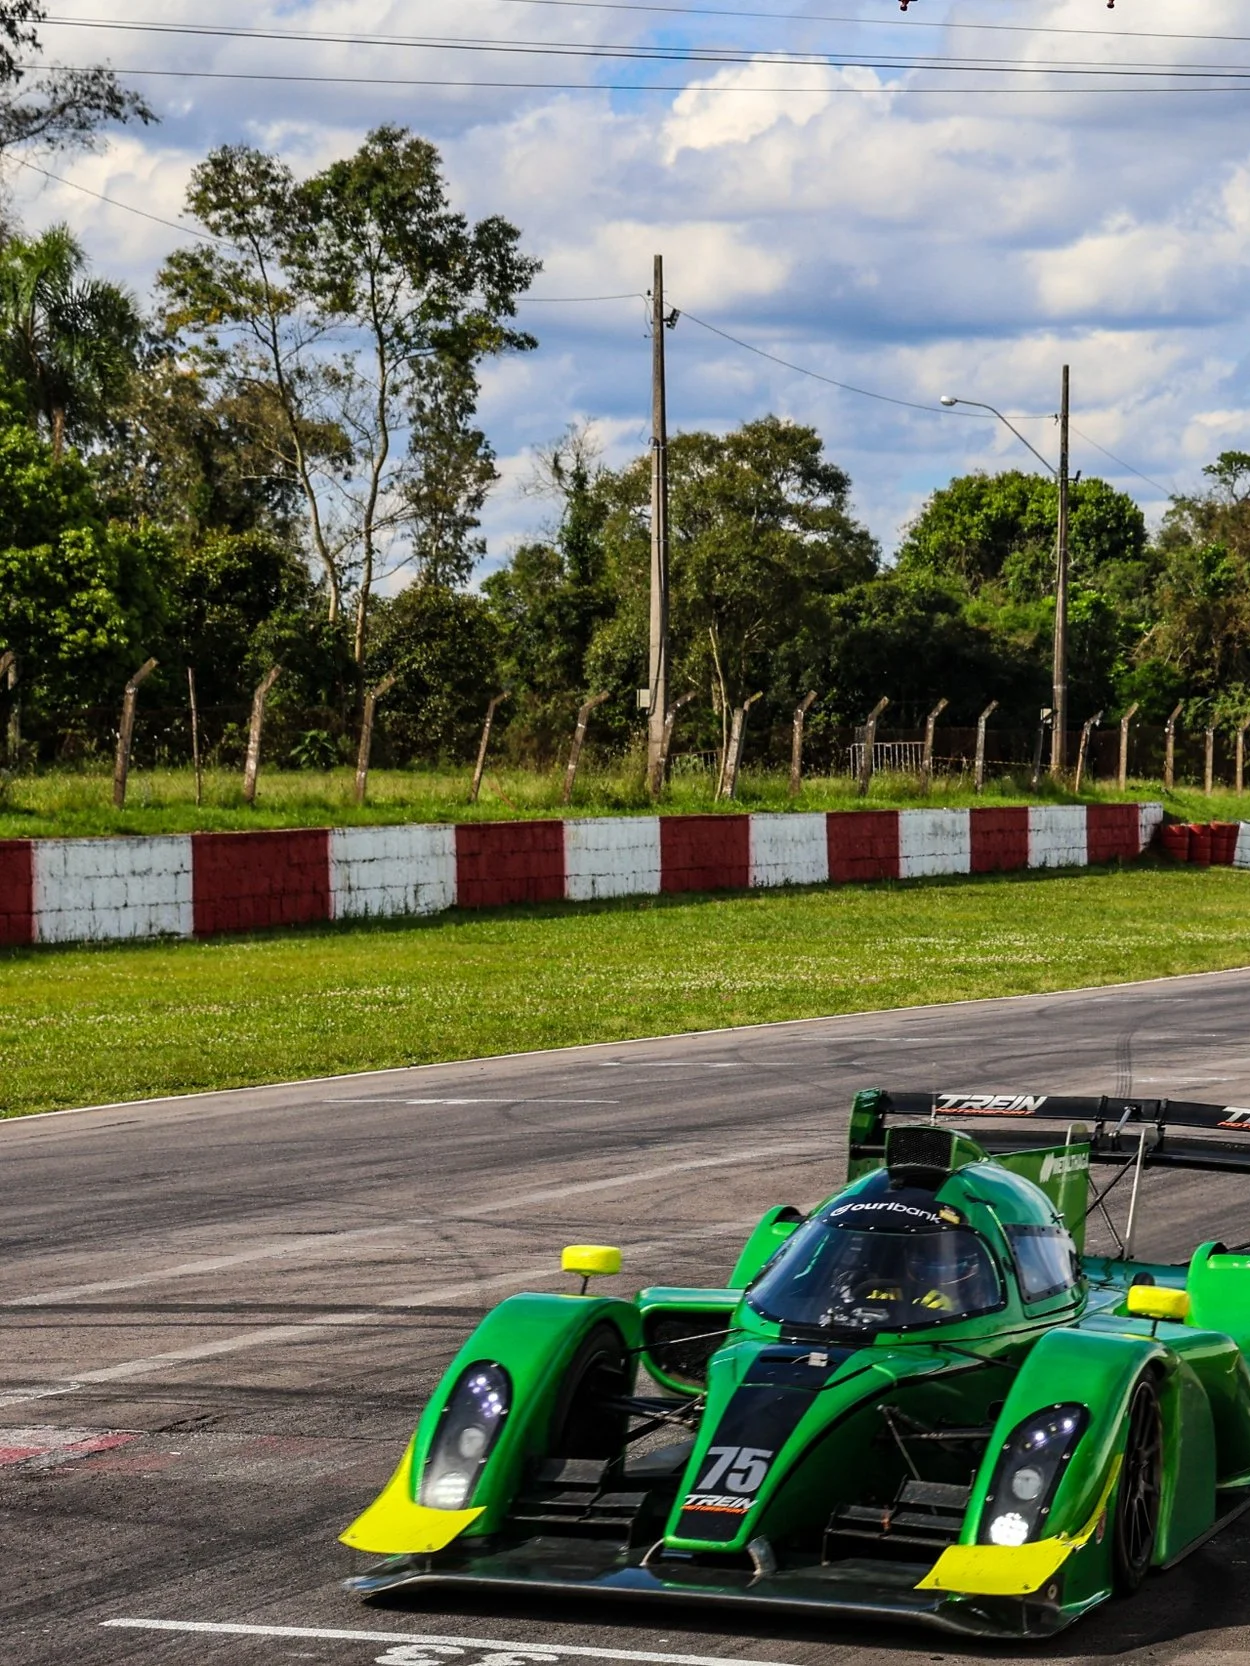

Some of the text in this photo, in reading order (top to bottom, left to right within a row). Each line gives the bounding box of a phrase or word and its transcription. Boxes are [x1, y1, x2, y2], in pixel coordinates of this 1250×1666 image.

[937, 1094, 1048, 1111] TREIN
[696, 1446, 774, 1493] 75
[684, 1494, 759, 1509] TREIN
